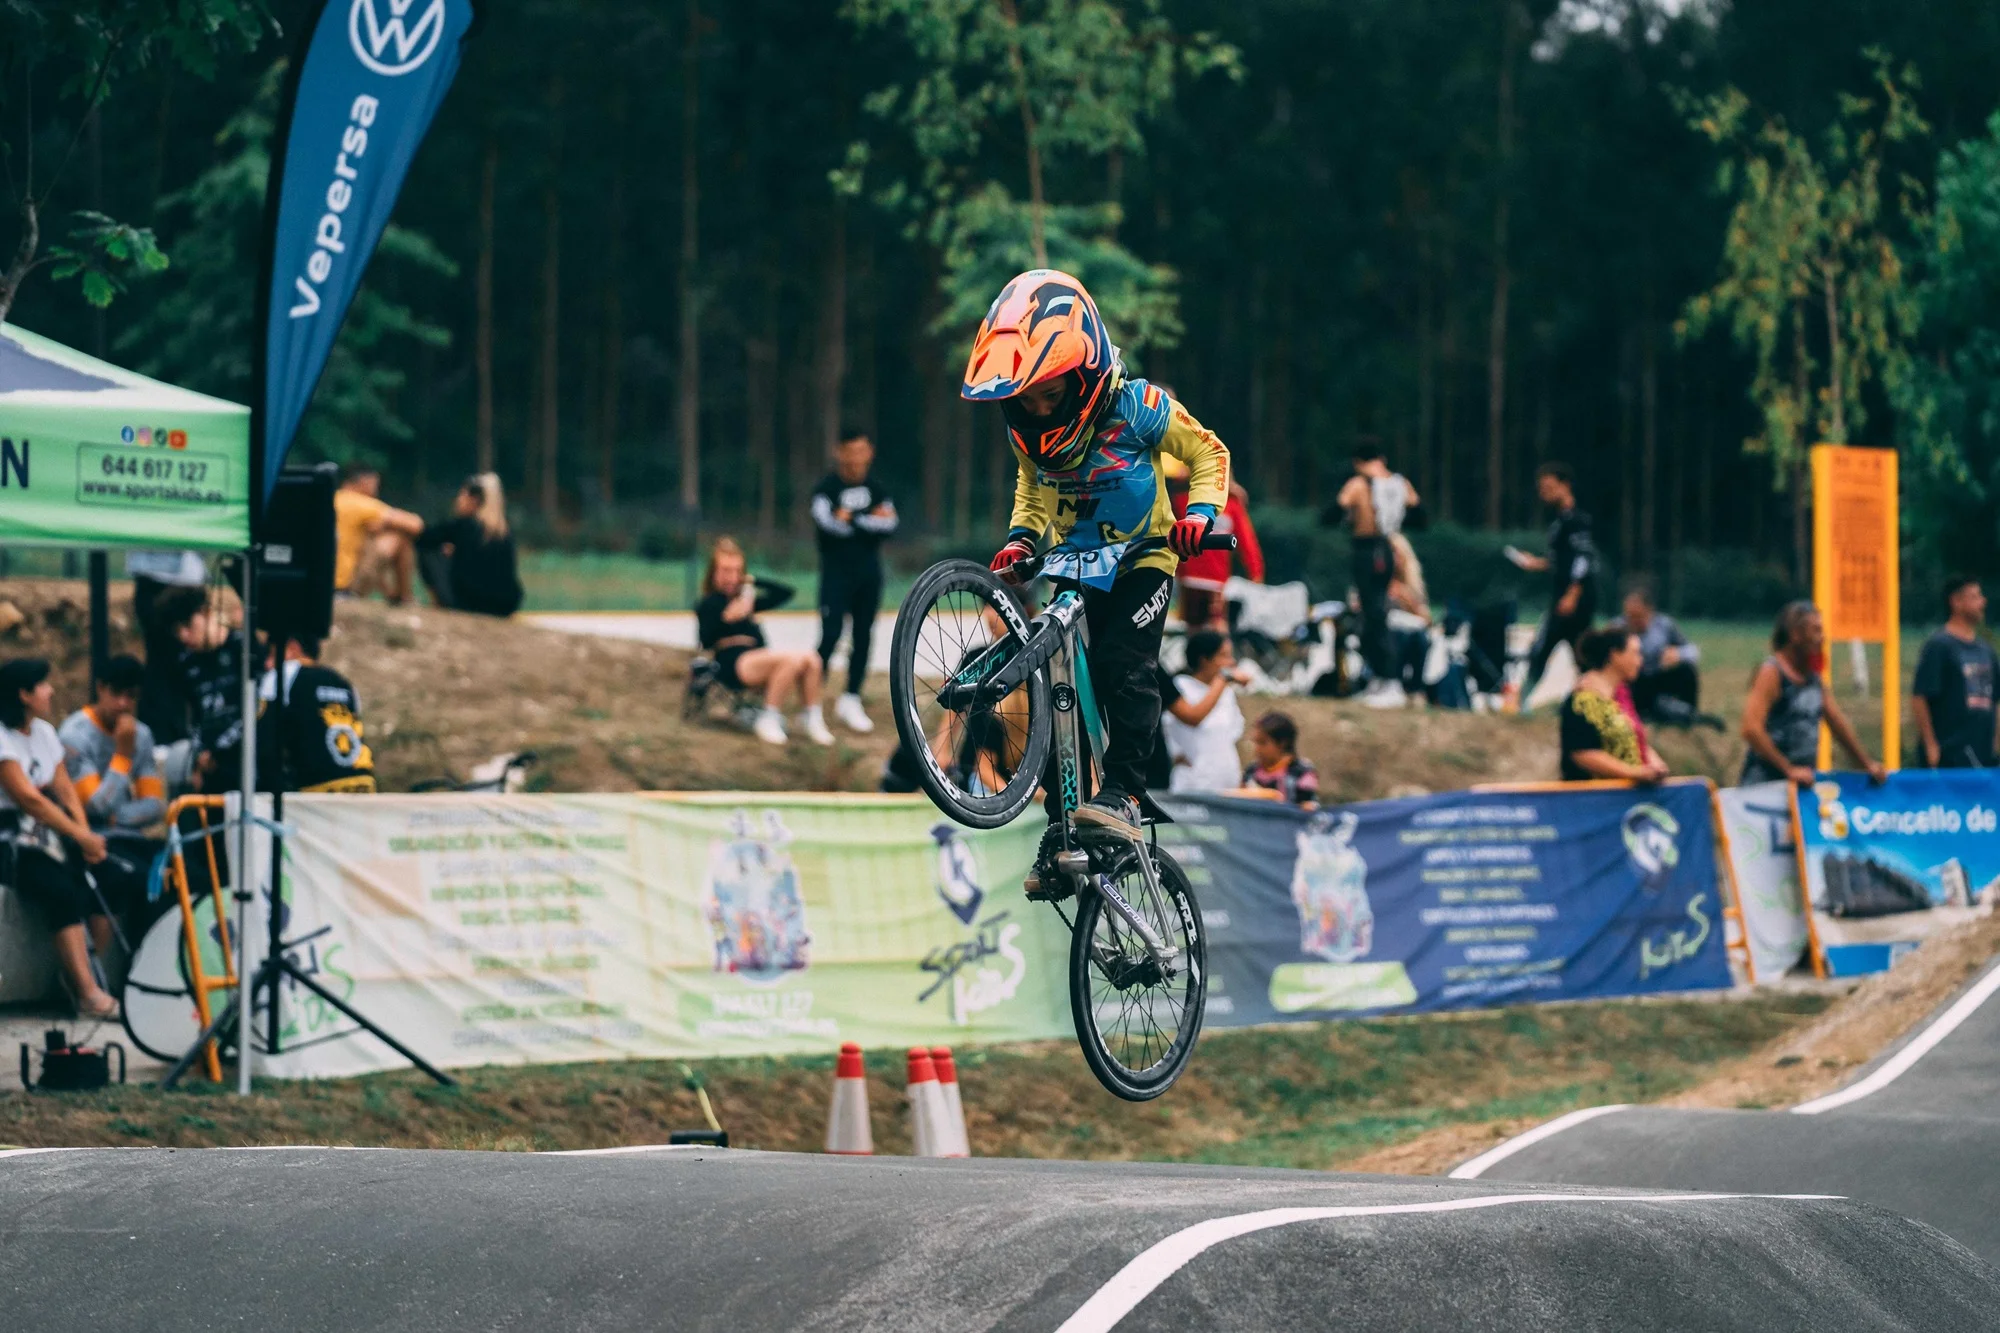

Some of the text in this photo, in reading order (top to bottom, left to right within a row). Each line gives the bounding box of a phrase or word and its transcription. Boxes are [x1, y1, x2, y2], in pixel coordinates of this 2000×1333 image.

[289, 94, 379, 318] Vepersa
[1, 437, 29, 488] N
[101, 453, 208, 482] 644 617 127
[1213, 455, 1227, 491] CLUB
[1131, 579, 1169, 629] SHOT
